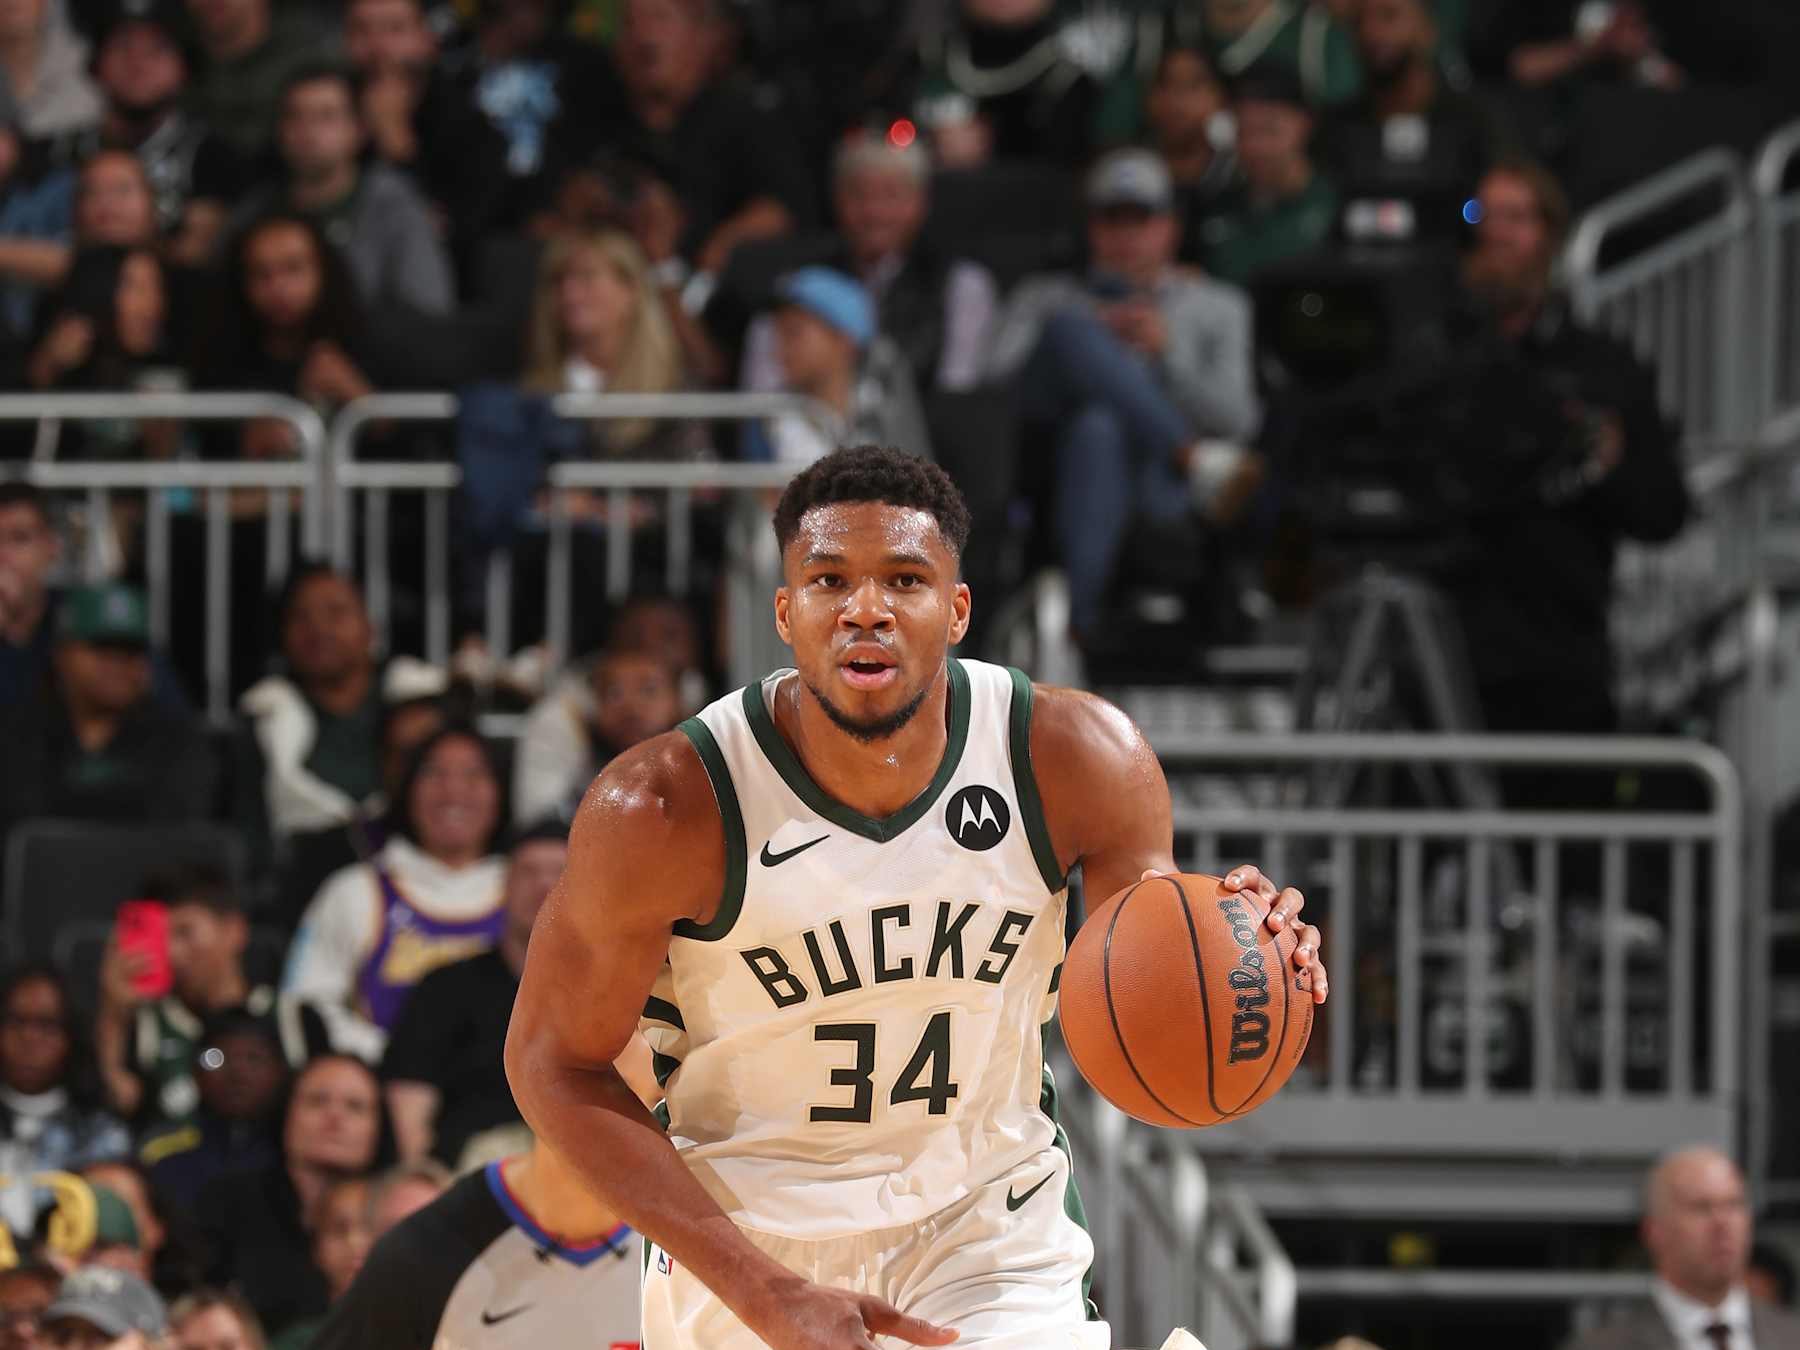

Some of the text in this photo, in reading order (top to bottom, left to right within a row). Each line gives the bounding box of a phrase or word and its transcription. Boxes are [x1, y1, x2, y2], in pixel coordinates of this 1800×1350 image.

[739, 900, 1035, 1009] BUCKS
[1217, 897, 1272, 1066] Wilson
[809, 1011, 958, 1124] 34
